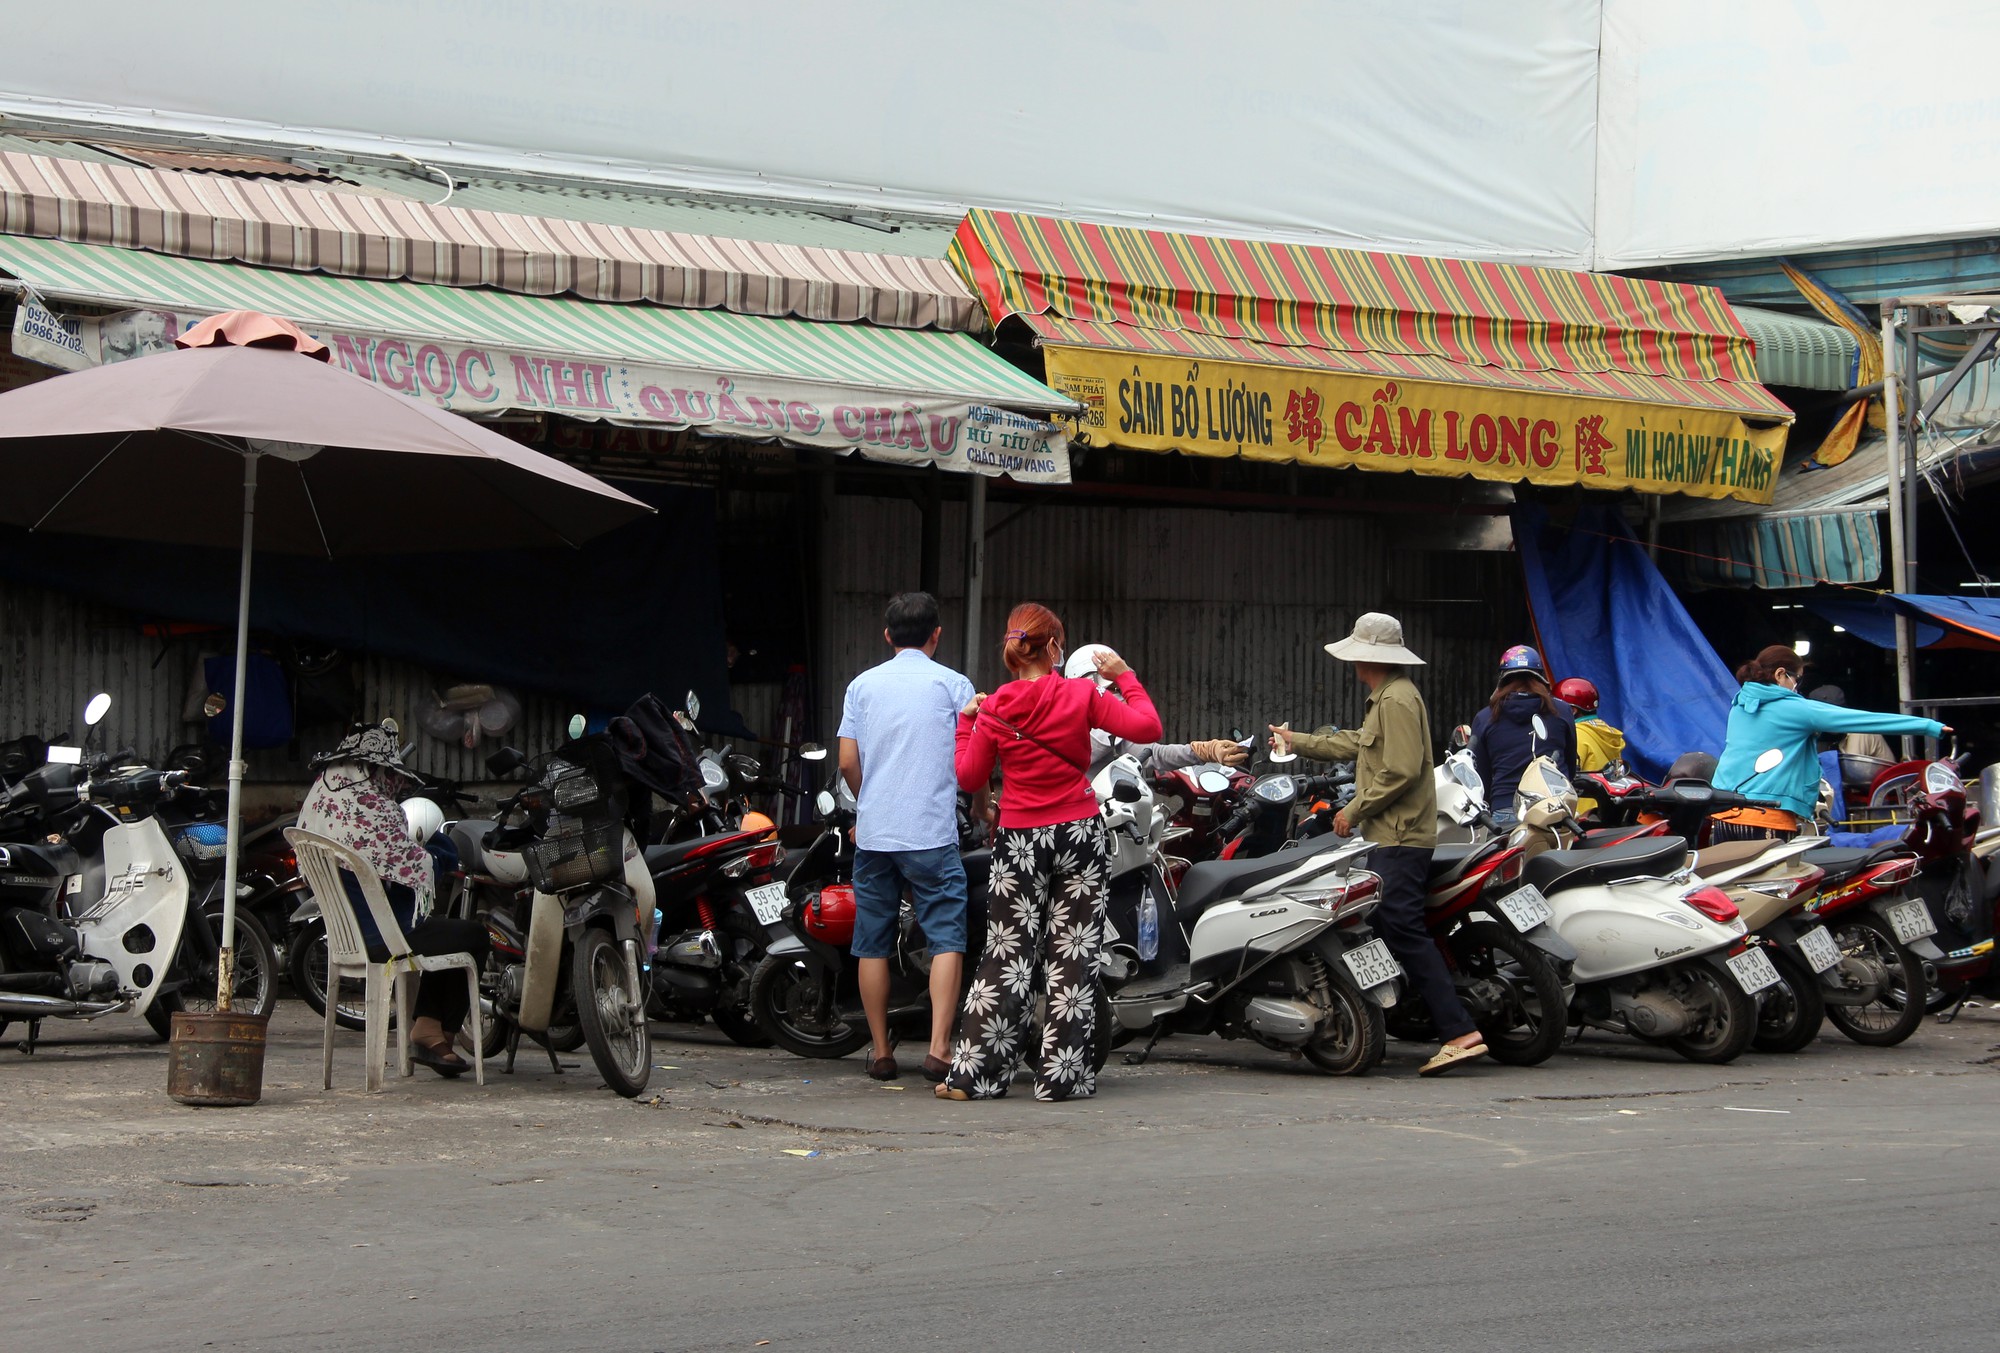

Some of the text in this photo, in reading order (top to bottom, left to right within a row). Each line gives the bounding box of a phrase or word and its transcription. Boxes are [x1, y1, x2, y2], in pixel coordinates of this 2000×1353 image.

[332, 334, 619, 412] NGỌC NHI
[639, 377, 961, 455] QUẢNG CHÂU
[1119, 362, 1273, 453] SÂM BỔ LƯỢNG
[1283, 386, 1324, 454] 錦
[1335, 382, 1560, 468] CẨM LONG
[1000, 432, 1031, 451] TÍU
[1575, 414, 1615, 475] 隆
[1625, 416, 1647, 479] MÌ
[1652, 419, 1711, 484] HOÀNH
[998, 454, 1023, 471] NAM
[1024, 457, 1057, 473] VANG
[14, 875, 49, 884] HONDA
[1249, 907, 1288, 918] LEAD
[1516, 902, 1549, 928] 3479
[1901, 918, 1931, 939] 6622
[1356, 958, 1396, 987] 205.33
[1740, 965, 1777, 992] 149.38
